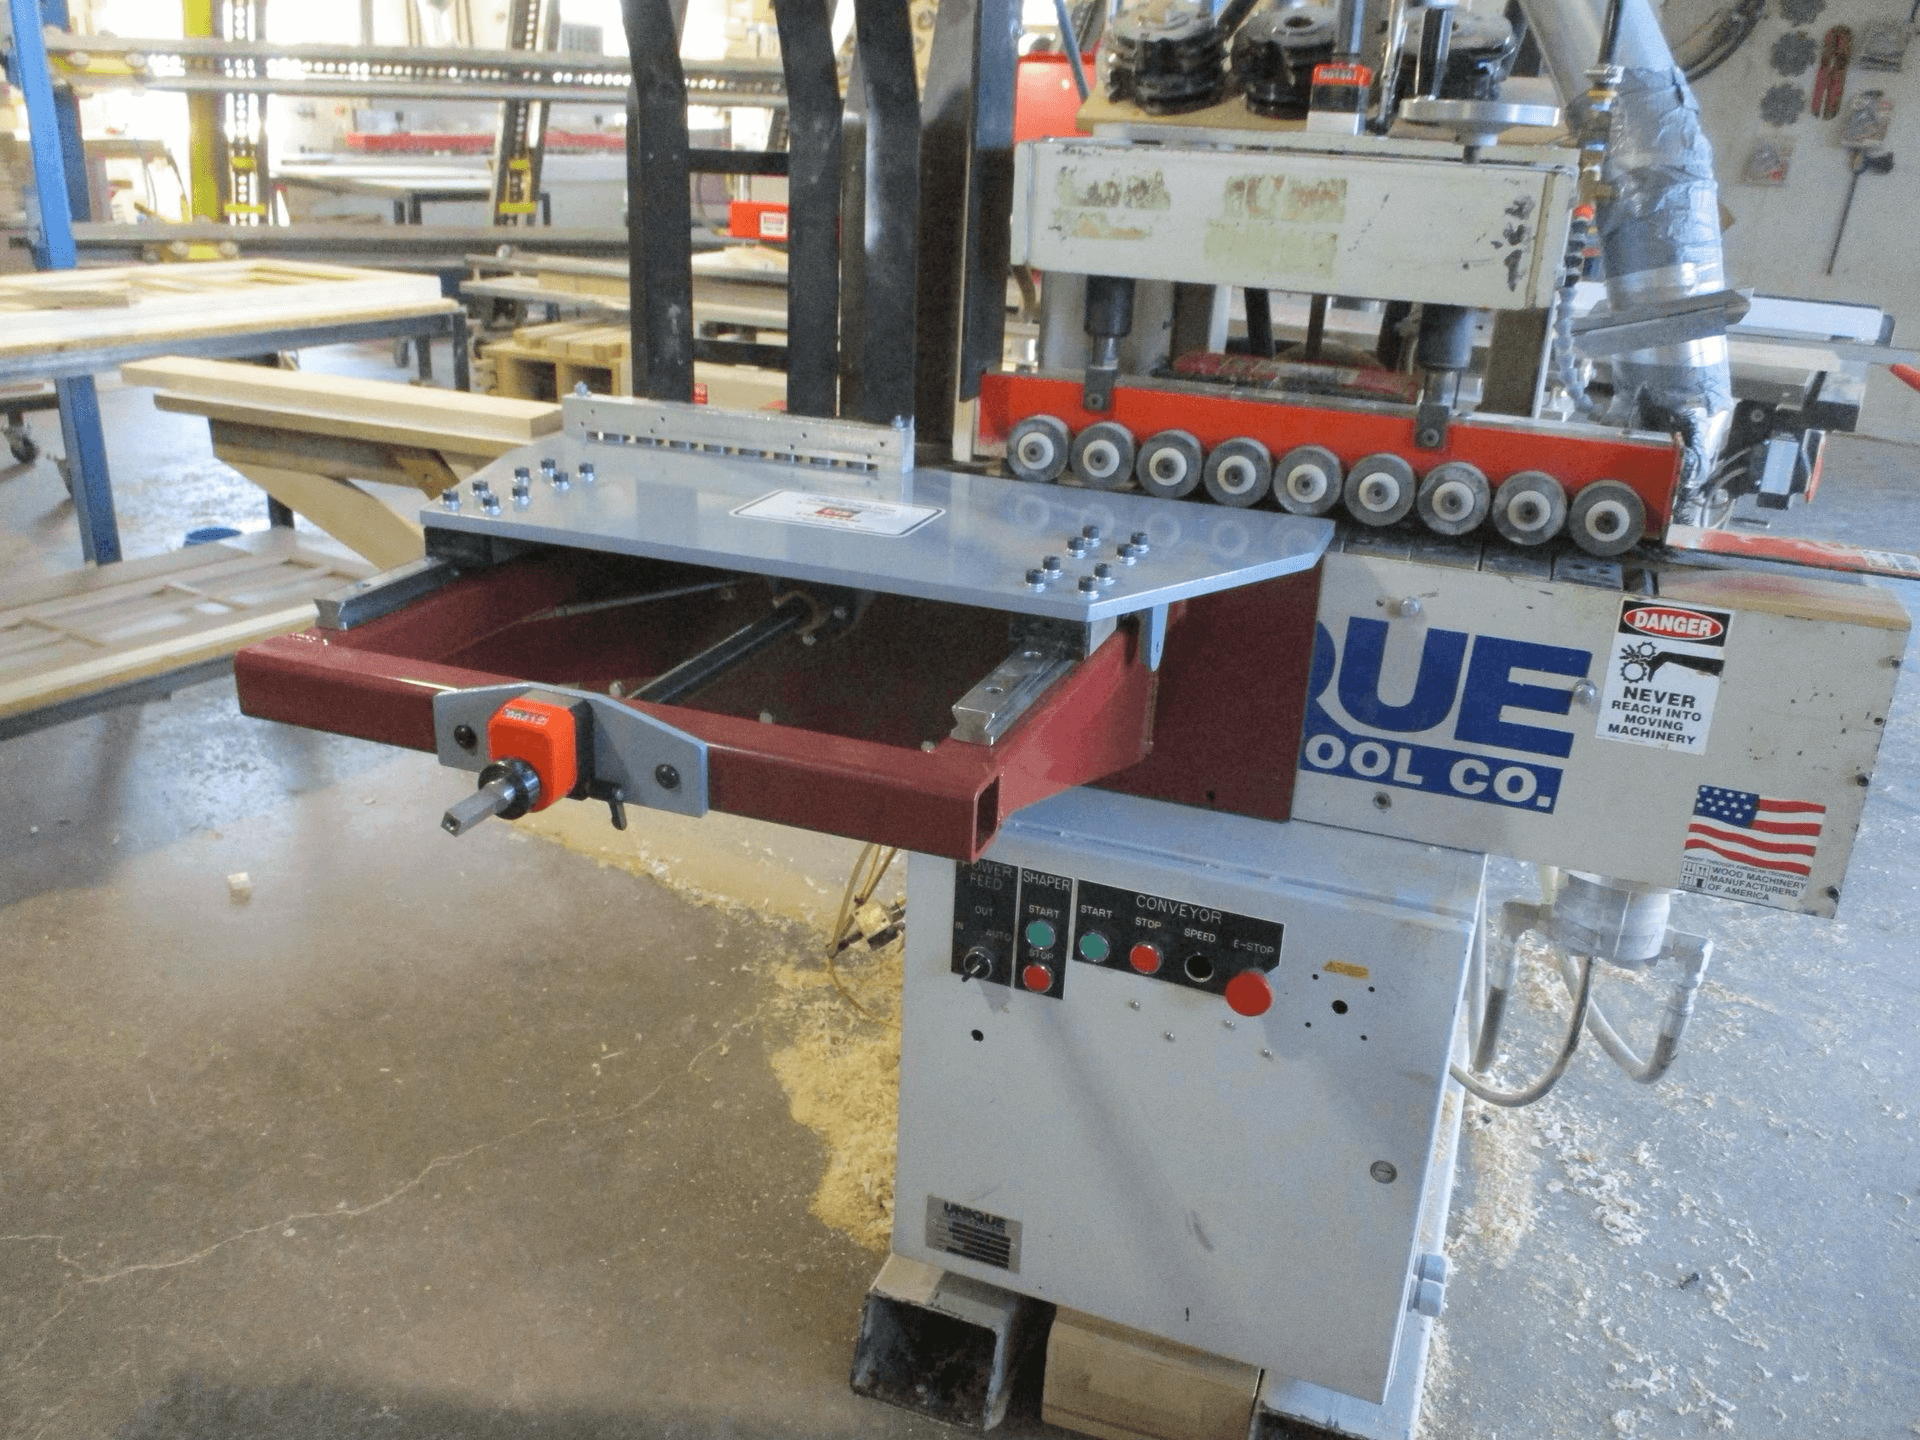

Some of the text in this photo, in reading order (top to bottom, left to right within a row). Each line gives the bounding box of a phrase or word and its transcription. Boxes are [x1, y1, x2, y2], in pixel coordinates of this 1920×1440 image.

[1633, 611, 1713, 637] DANGER
[1623, 686, 1696, 708] NEVER
[1611, 700, 1702, 722] REACH INTO
[1624, 714, 1684, 731] MOVING
[1608, 723, 1696, 745] MACHINERY
[1449, 758, 1552, 808] CO.
[1023, 870, 1071, 892] SHAPER
[1709, 874, 1799, 897] MANUFACTURERS
[1711, 866, 1807, 890] WOOD MACHINERY
[1707, 883, 1722, 892] OF
[1724, 886, 1770, 901] AMERICA
[974, 905, 993, 917] OUT
[1028, 904, 1060, 919] START
[1080, 904, 1113, 919] START
[1136, 894, 1222, 925] CONVEYOR
[1135, 916, 1162, 929] STOP
[1184, 928, 1216, 943] SPEED
[1029, 949, 1054, 960] STOP
[1233, 939, 1275, 954] E-STOP
